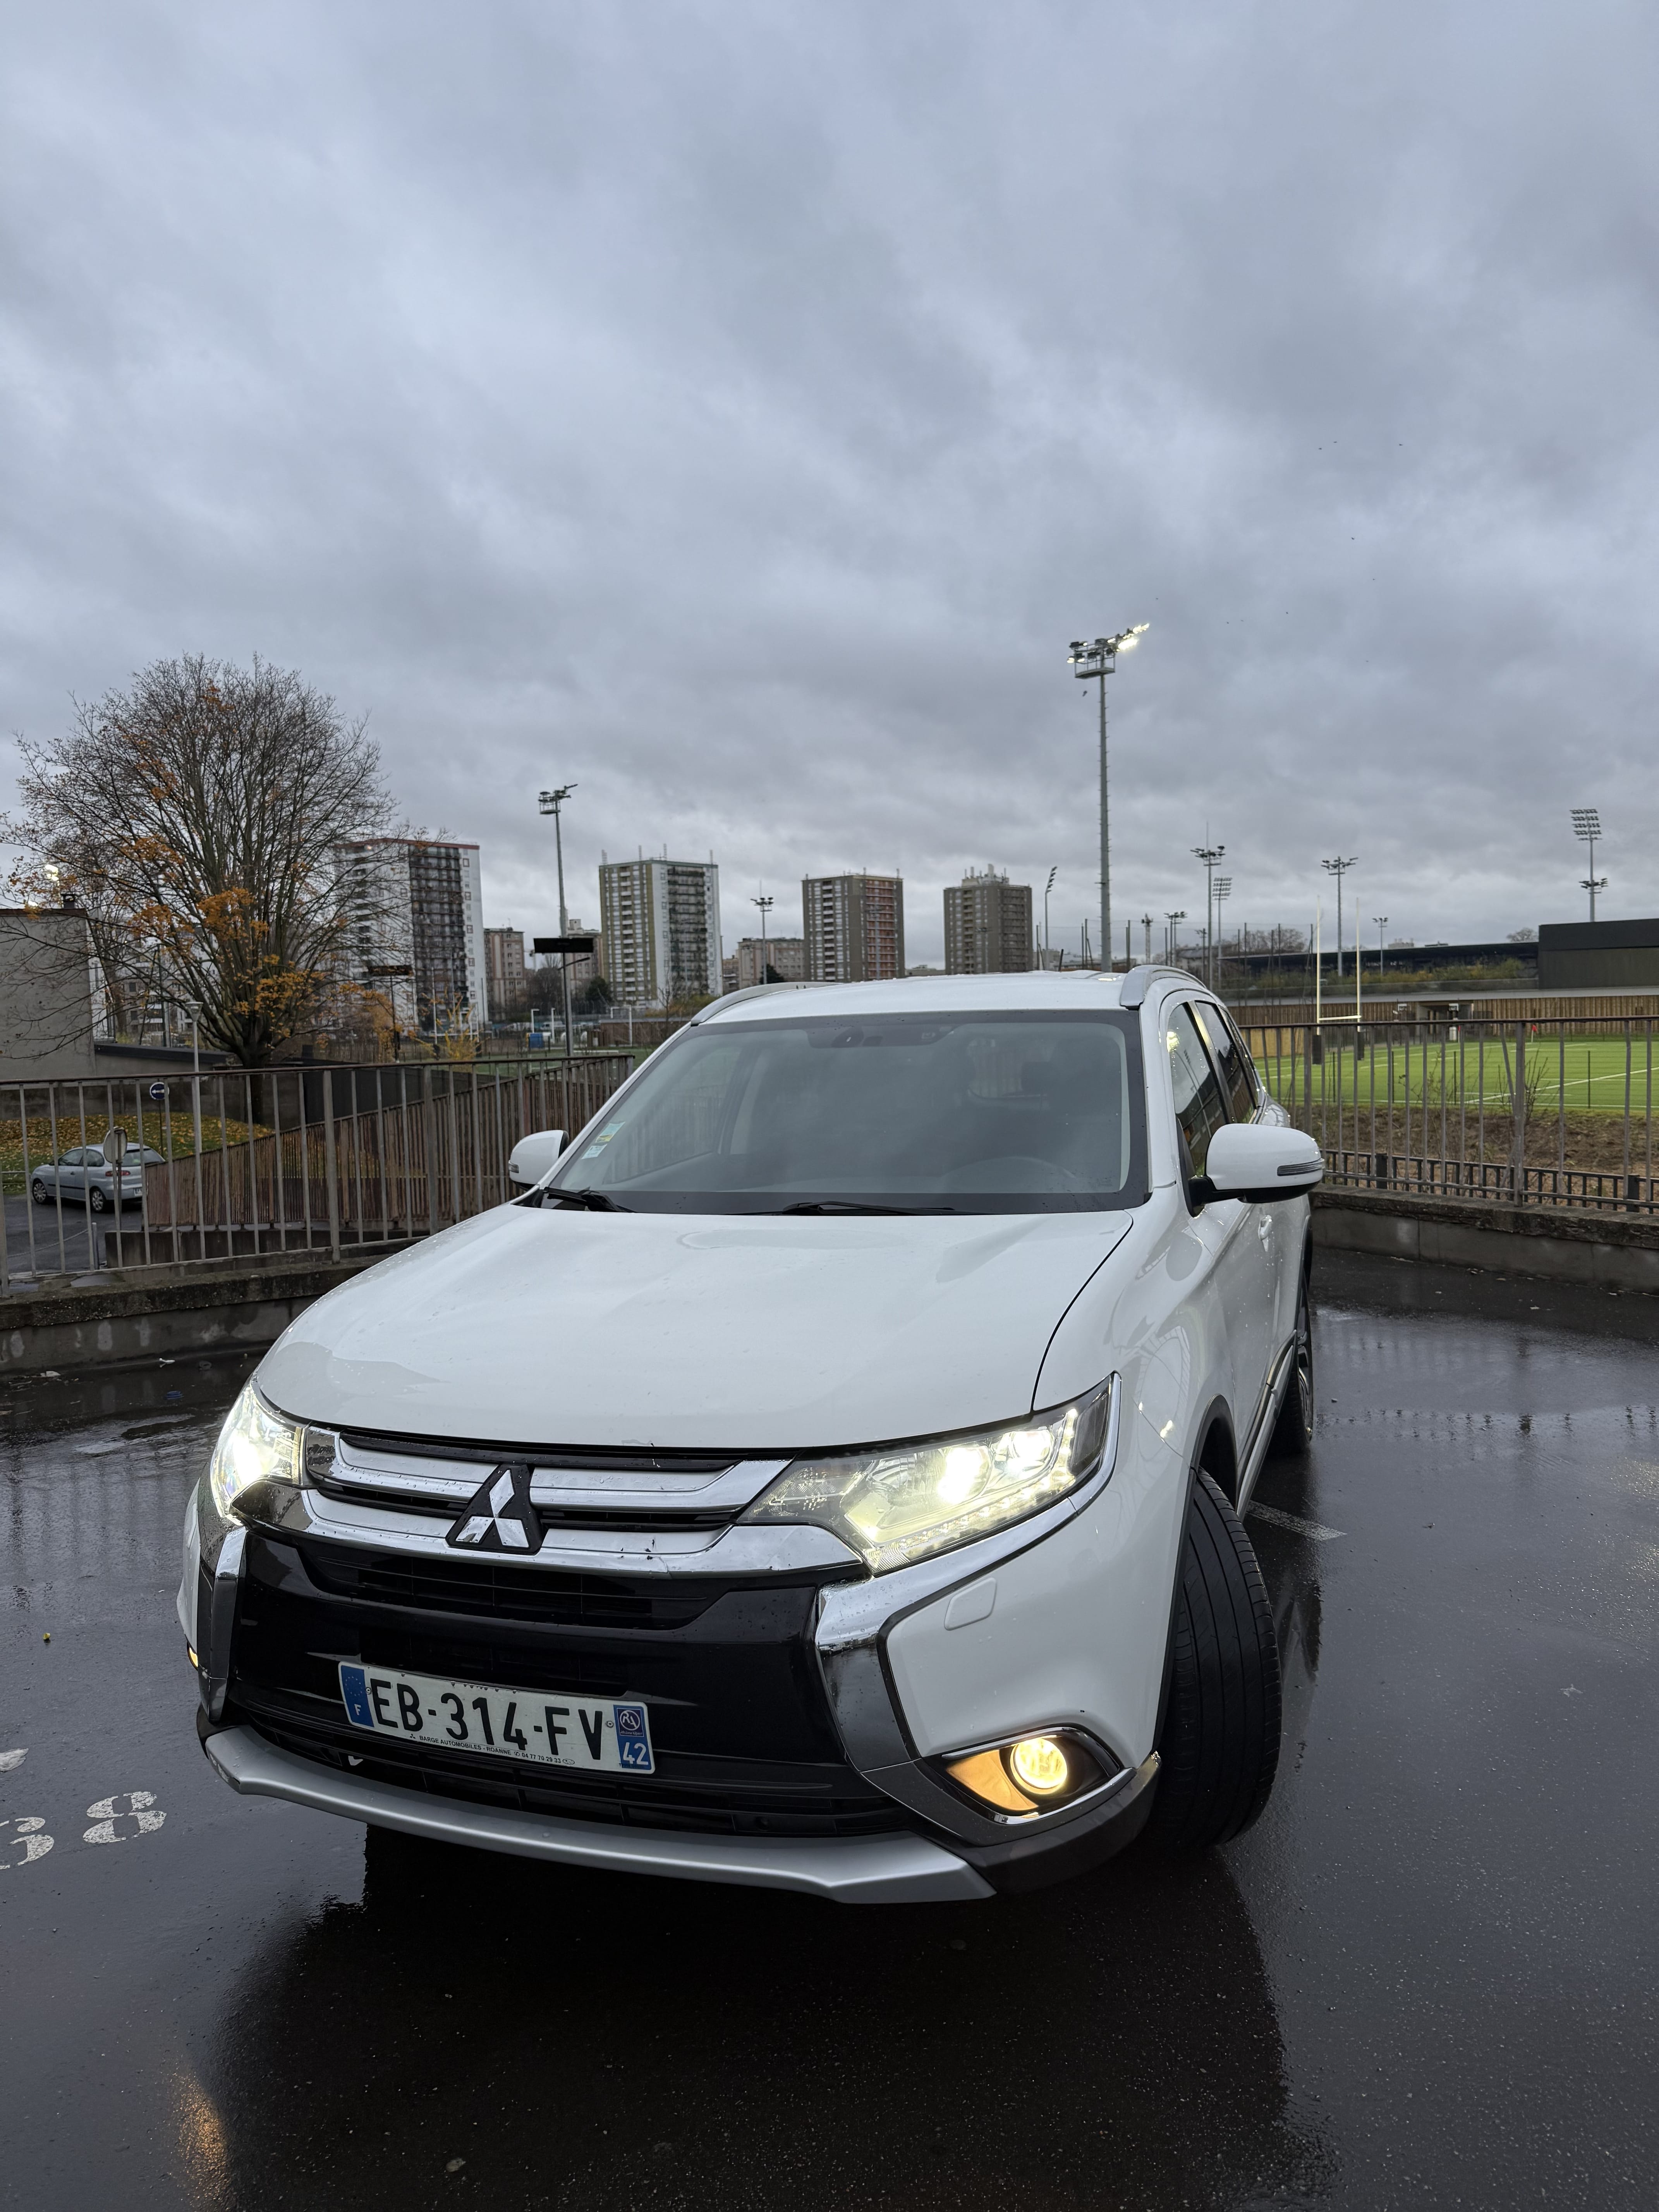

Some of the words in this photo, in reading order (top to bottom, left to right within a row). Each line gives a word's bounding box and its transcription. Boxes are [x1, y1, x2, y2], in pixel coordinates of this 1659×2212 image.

[354, 1704, 361, 1716] F
[370, 1678, 603, 1760] EB-314-FV
[441, 1740, 481, 1750] AUTOMOBILES
[486, 1747, 512, 1755] ROANNE
[623, 1742, 649, 1765] 42
